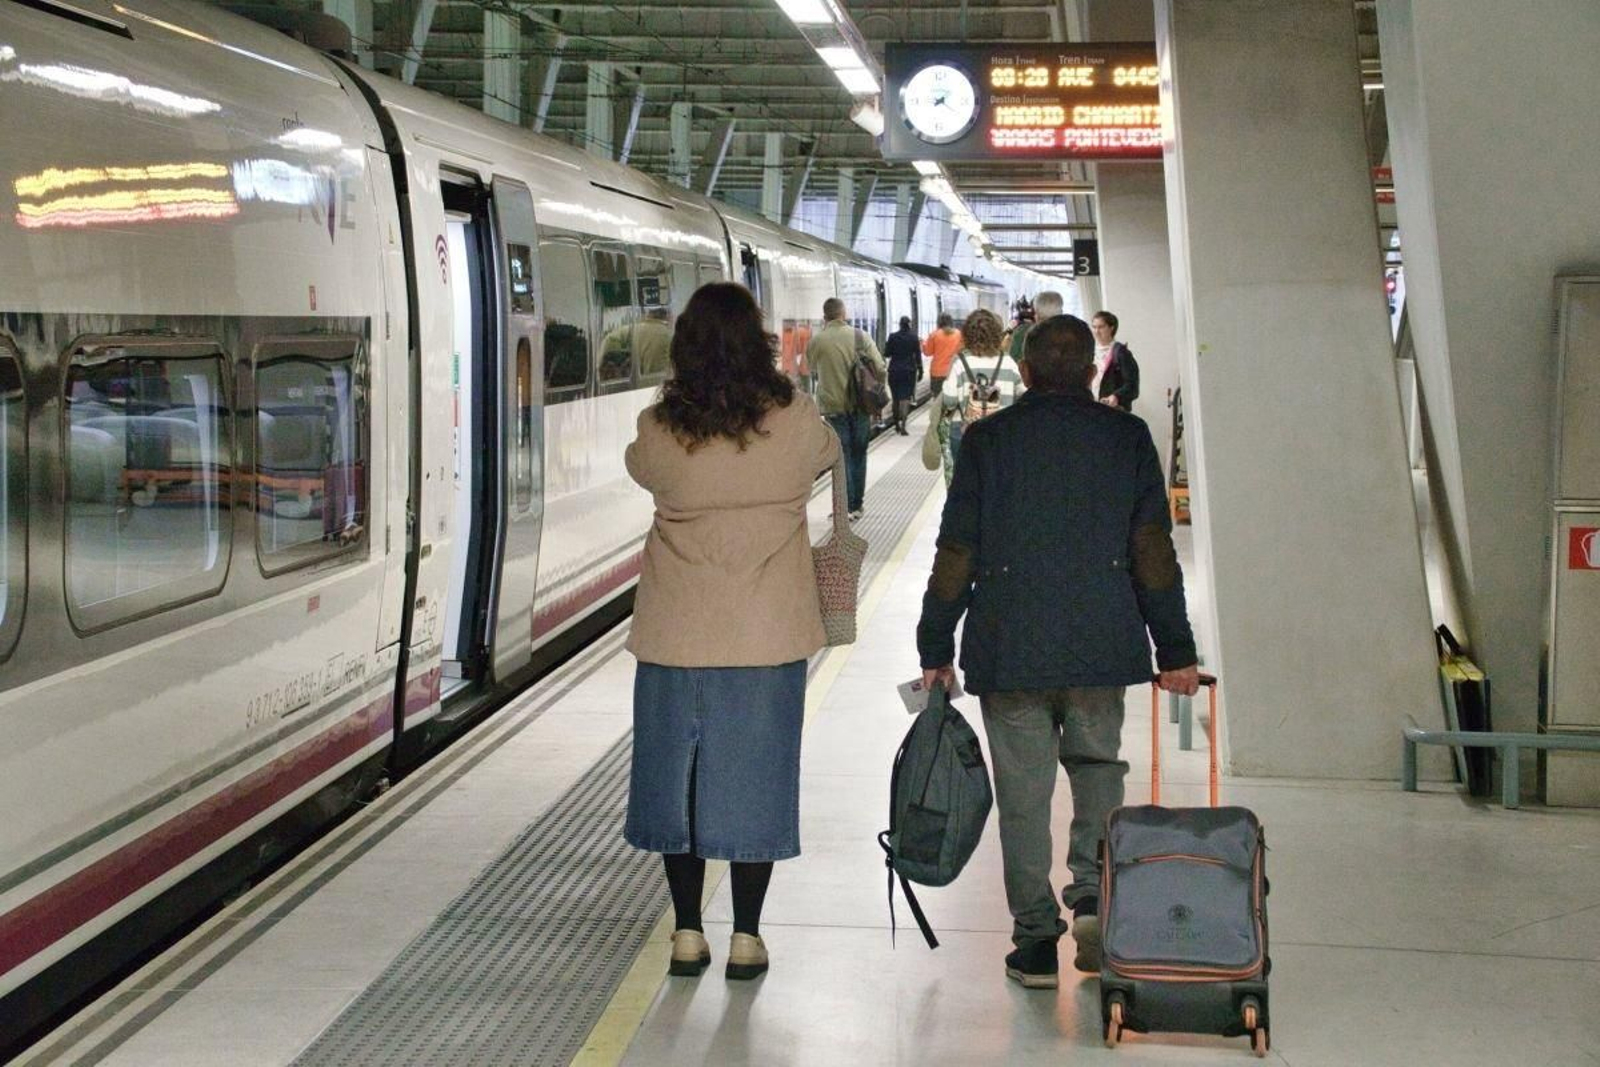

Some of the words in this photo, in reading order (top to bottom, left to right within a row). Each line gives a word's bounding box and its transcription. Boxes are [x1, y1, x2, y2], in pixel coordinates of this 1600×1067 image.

[1058, 67, 1095, 86] AVE
[995, 105, 1065, 126] MADRID
[1078, 256, 1091, 275] 3
